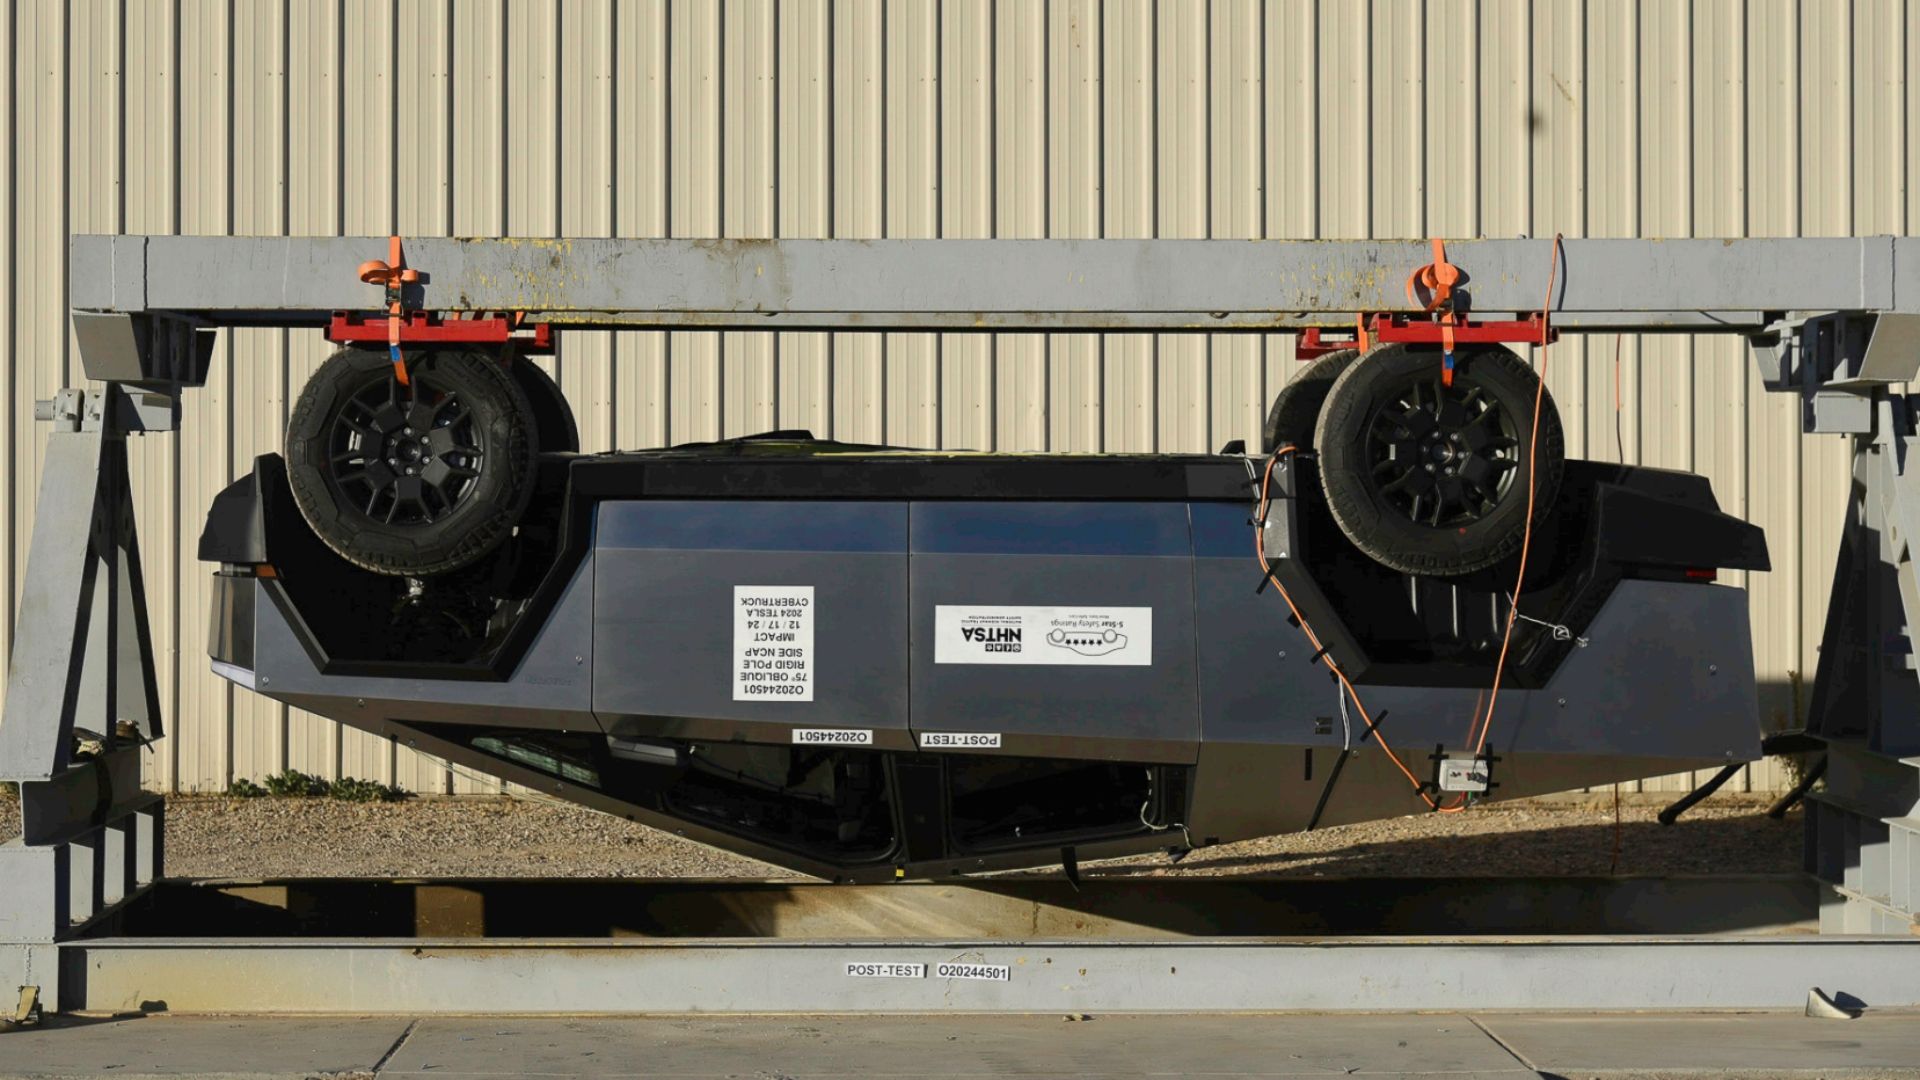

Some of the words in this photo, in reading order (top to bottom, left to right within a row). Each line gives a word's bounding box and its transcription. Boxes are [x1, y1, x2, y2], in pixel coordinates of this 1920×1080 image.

[740, 597, 809, 607] CYBERTRUCK
[746, 608, 778, 618] TESLA
[781, 609, 803, 618] 2024
[747, 621, 760, 629] 24
[768, 621, 780, 629] 17
[789, 621, 800, 629] 12
[1050, 618, 1077, 628] Ratings
[1078, 619, 1100, 628] Safety
[754, 632, 795, 642] IMPACT
[961, 627, 1022, 643] NHTSA
[745, 647, 775, 657] NCAP
[779, 647, 803, 657] SIDE
[744, 660, 773, 670] POLE
[775, 660, 805, 670] RIGID
[740, 672, 789, 682] OBLIQUE
[799, 731, 868, 743] O20244501
[924, 734, 998, 745] POST-TEST
[847, 965, 920, 976] POST-TEST
[938, 965, 1006, 979] O20244501
